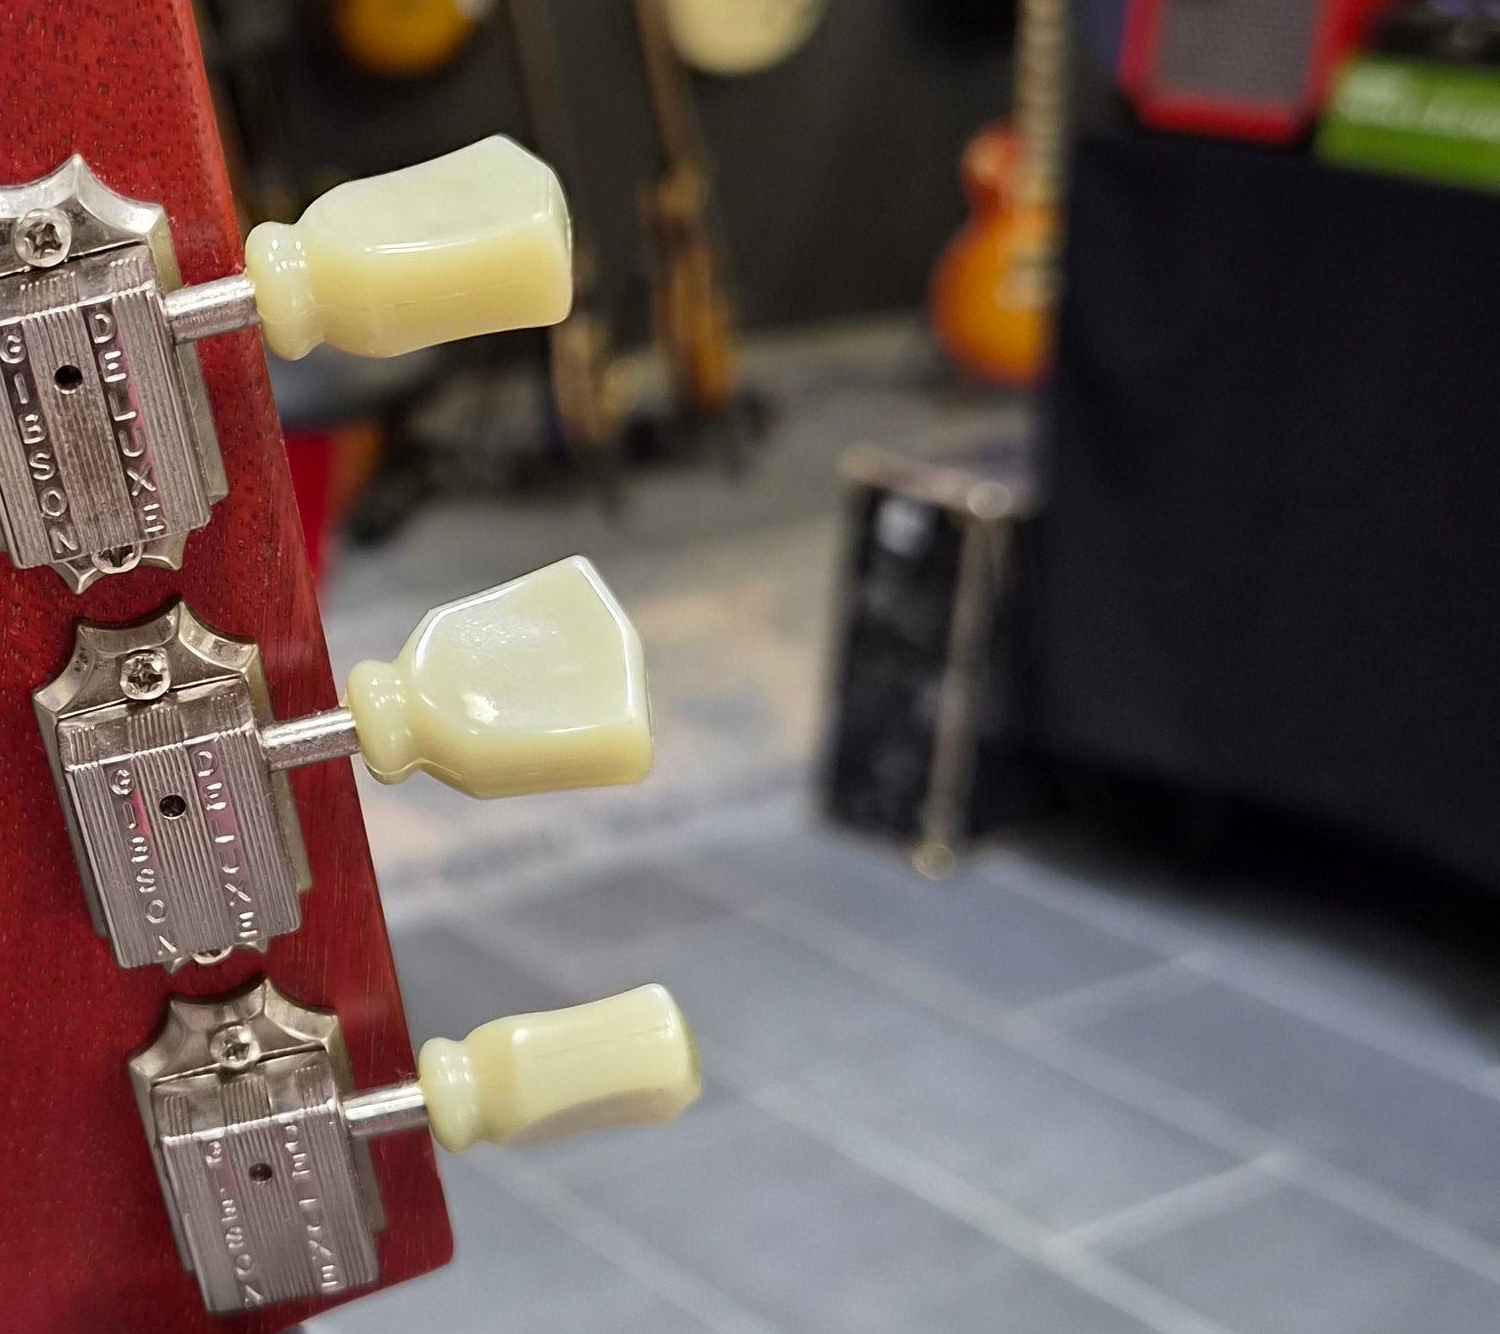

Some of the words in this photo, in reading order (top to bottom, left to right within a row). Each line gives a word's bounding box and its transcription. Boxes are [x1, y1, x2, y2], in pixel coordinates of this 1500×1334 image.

[0, 333, 79, 554] GIBSON
[93, 312, 166, 536] DELUXE
[110, 769, 178, 955] GIBSON
[205, 1140, 263, 1307] GBSON
